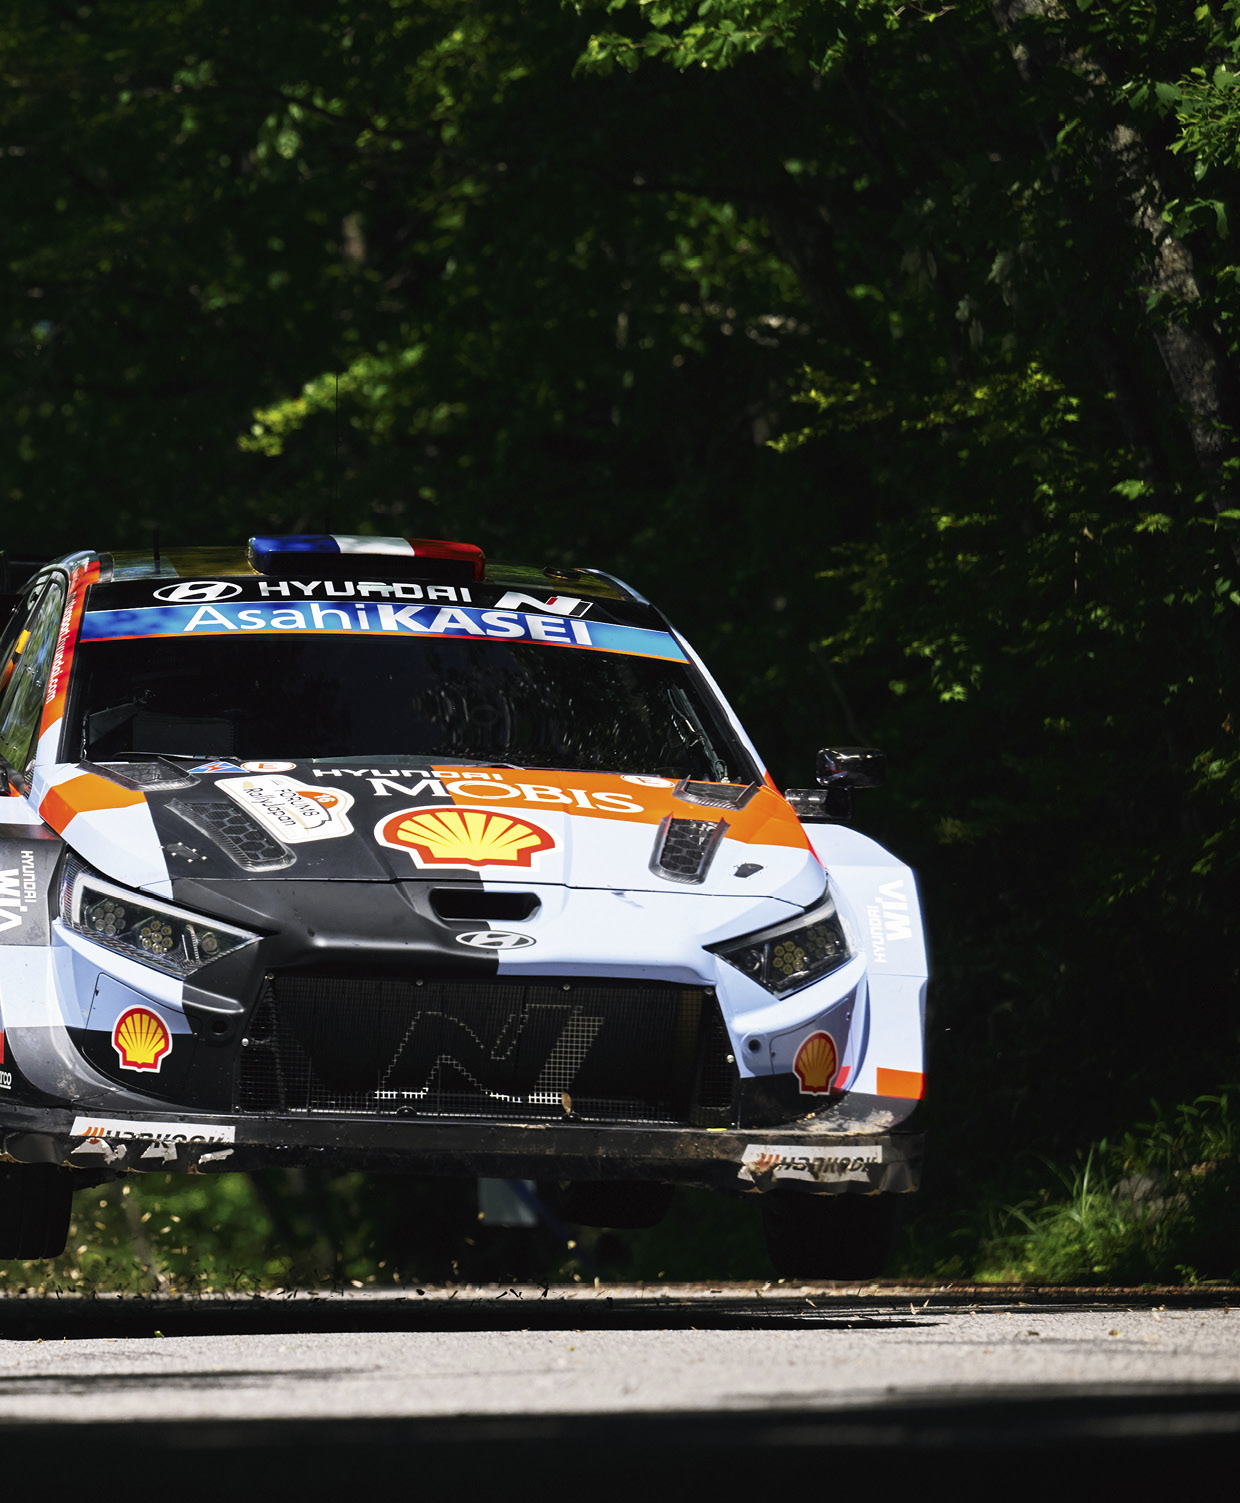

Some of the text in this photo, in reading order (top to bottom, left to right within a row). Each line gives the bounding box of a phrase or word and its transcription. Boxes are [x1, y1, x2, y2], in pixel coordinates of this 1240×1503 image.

[258, 581, 472, 603] HYUNDAI
[312, 769, 504, 781] HYUNDAI
[366, 778, 645, 814] MOBIS
[21, 850, 37, 903] HYUNDAI
[866, 905, 887, 963] HYUNDAI
